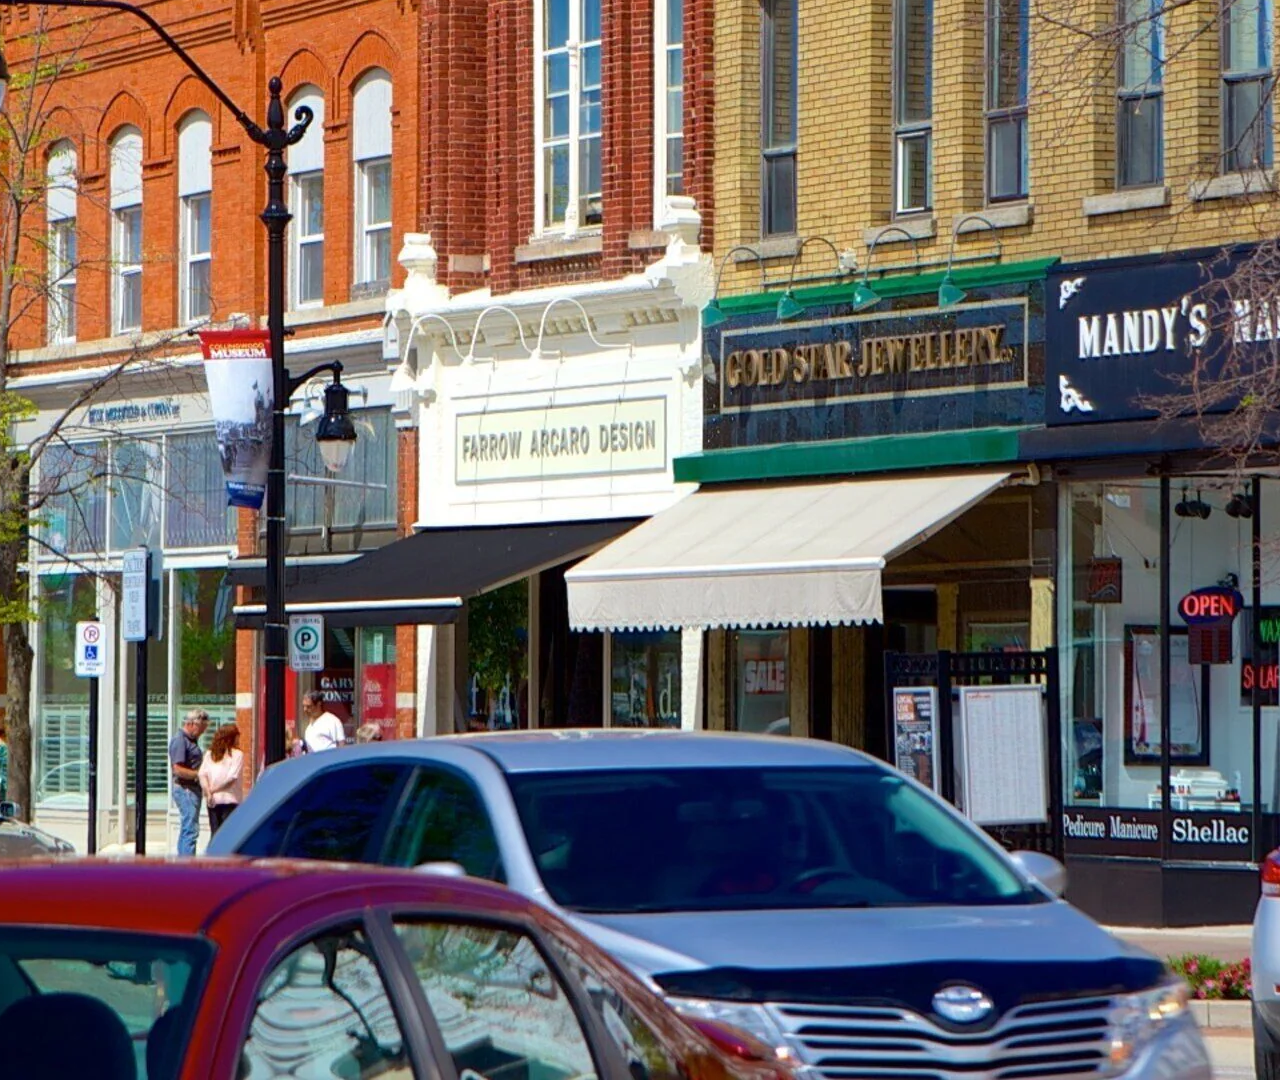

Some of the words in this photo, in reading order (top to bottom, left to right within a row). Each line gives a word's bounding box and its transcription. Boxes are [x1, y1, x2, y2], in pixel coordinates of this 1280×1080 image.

[1078, 296, 1208, 360] MANDY'S
[209, 342, 265, 351] COLLINGWOOD
[210, 348, 267, 359] MUSEUM
[725, 348, 789, 388] GOLD
[793, 340, 853, 383] STAR
[856, 324, 1006, 378] JEWELLERY
[462, 430, 522, 463] FARROW
[530, 426, 590, 459] ARCARO
[599, 419, 656, 453] DESIGN
[1183, 594, 1234, 617] OPEN
[745, 660, 785, 692] SALE
[1063, 813, 1106, 839] Pedicure
[1109, 815, 1158, 841] Manicure
[1172, 818, 1249, 843] Shellac
